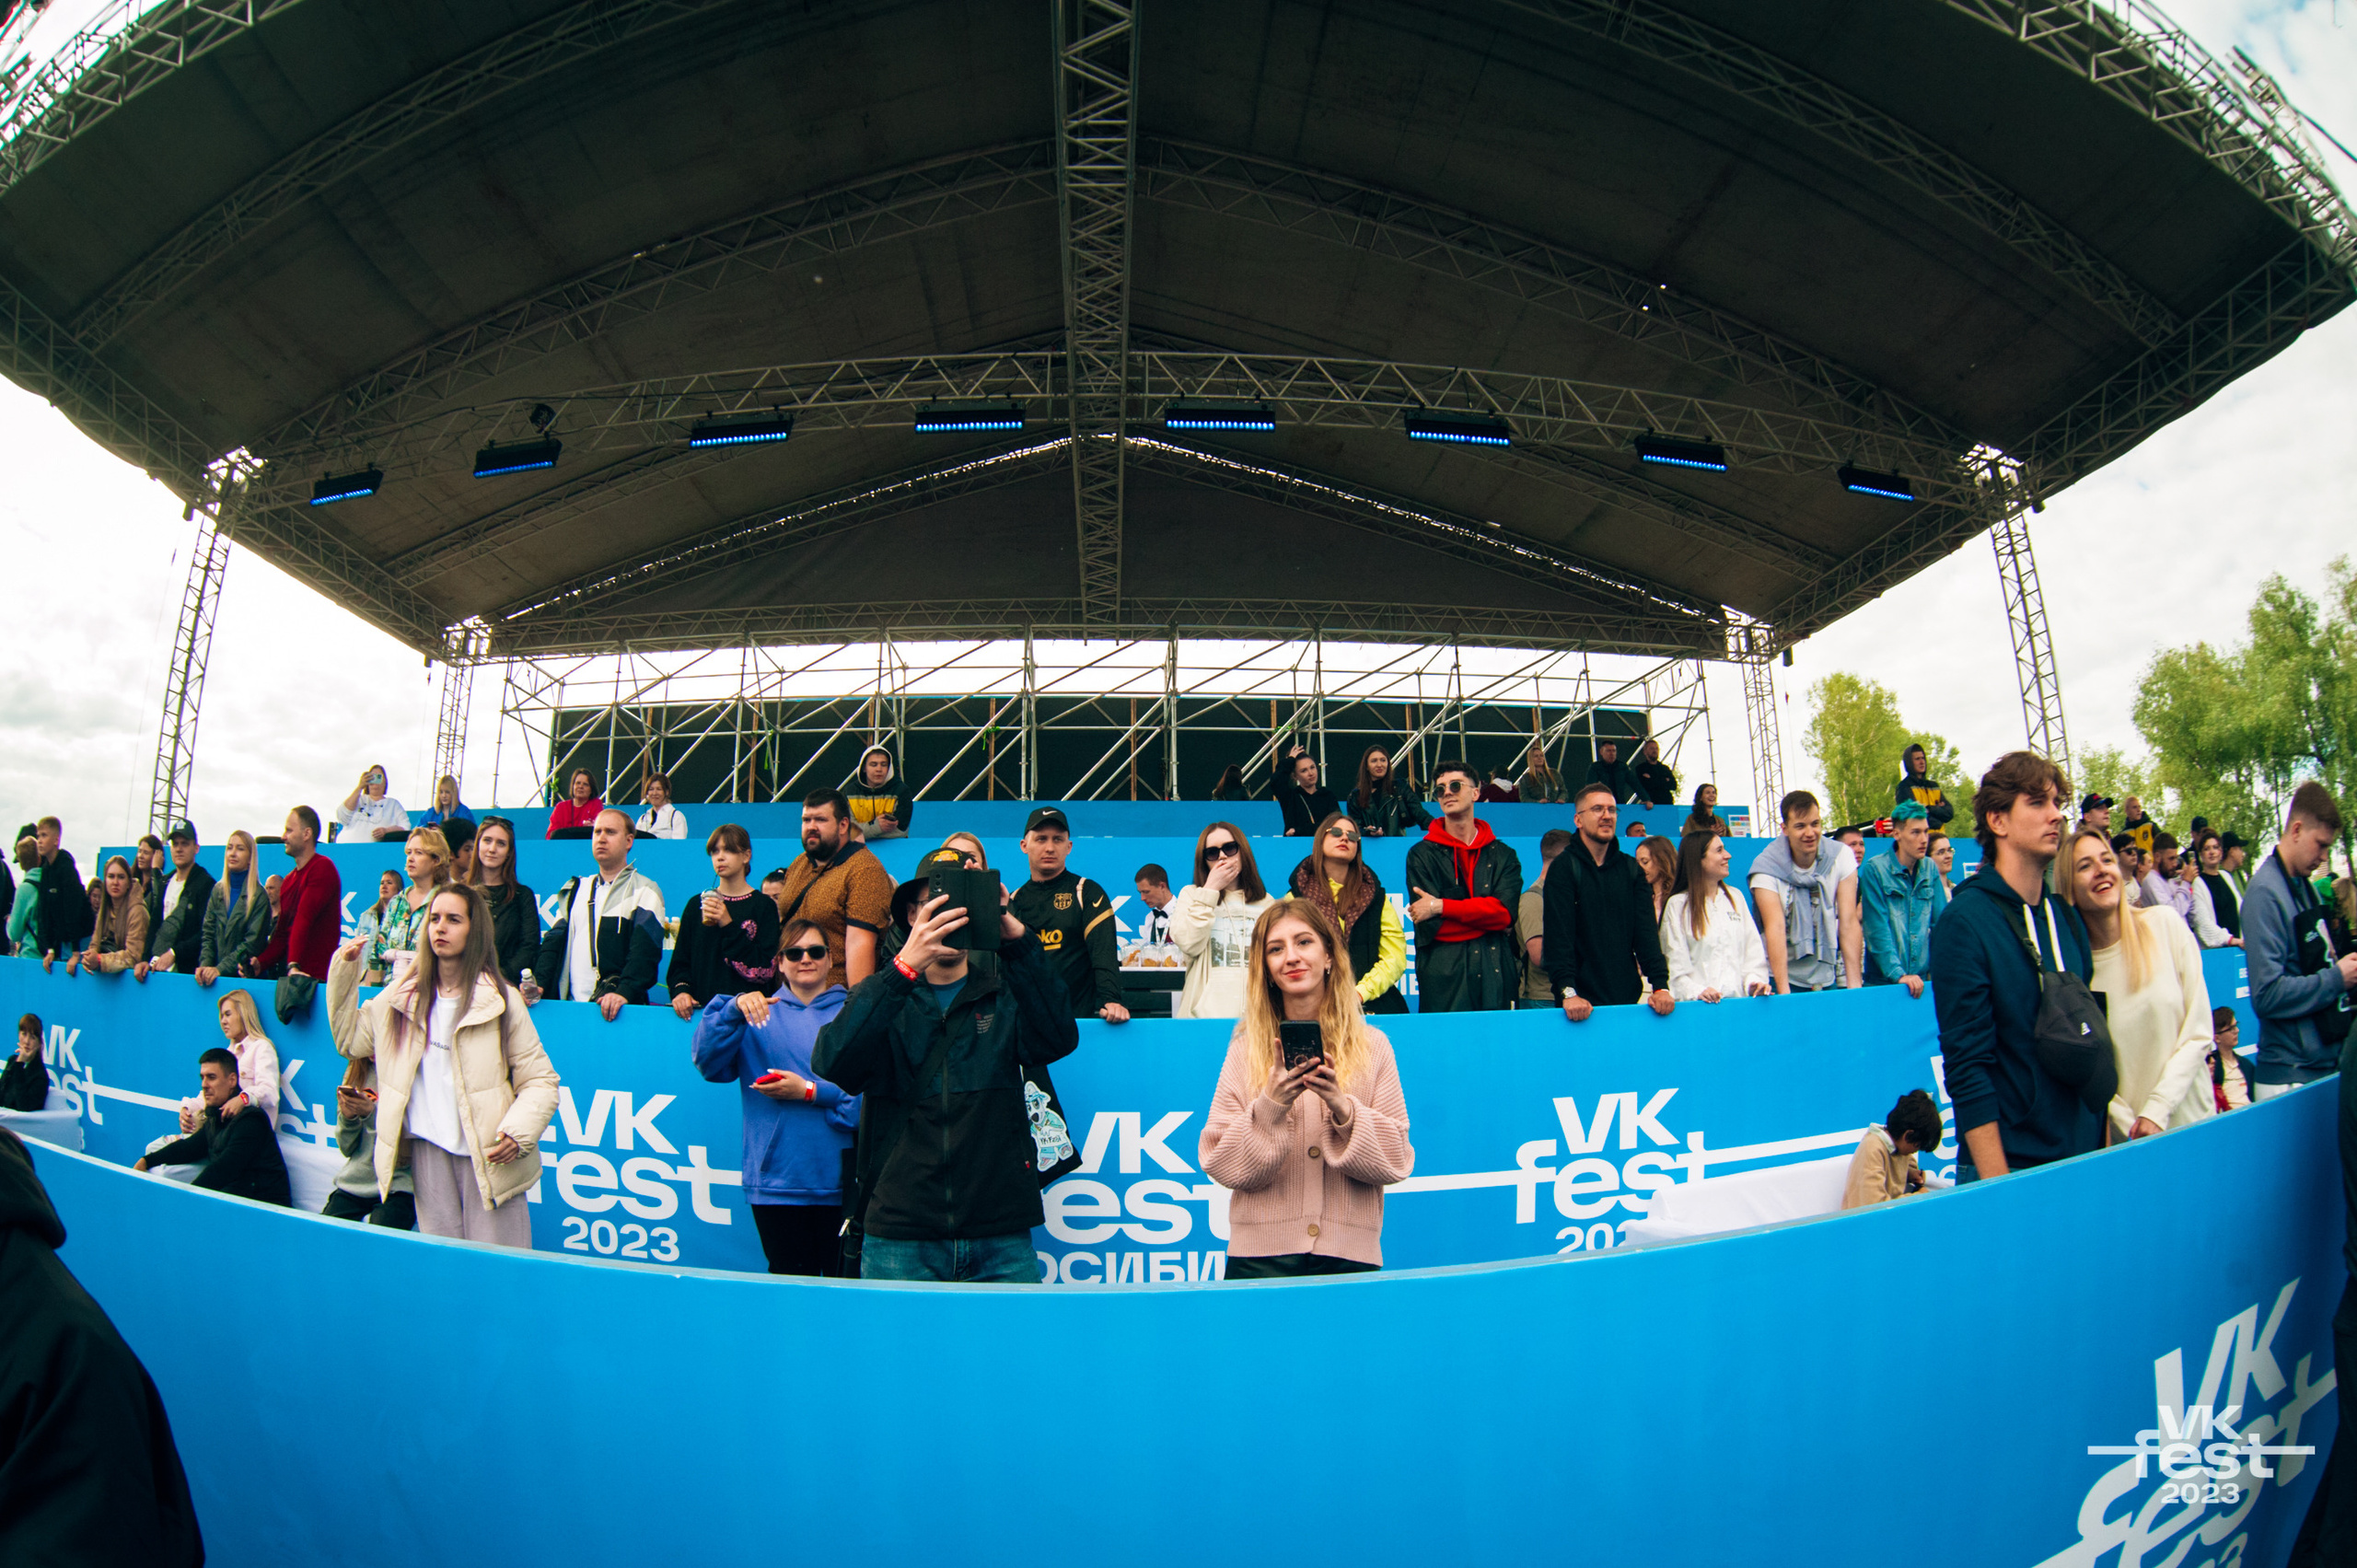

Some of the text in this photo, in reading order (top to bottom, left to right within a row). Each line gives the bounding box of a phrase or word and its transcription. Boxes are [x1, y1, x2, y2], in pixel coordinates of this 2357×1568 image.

[558, 1085, 680, 1155] VK
[1552, 1087, 1680, 1155] VK
[562, 1215, 680, 1262] 2023
[1041, 1173, 1231, 1245] est
[2154, 1276, 2303, 1473] VK
